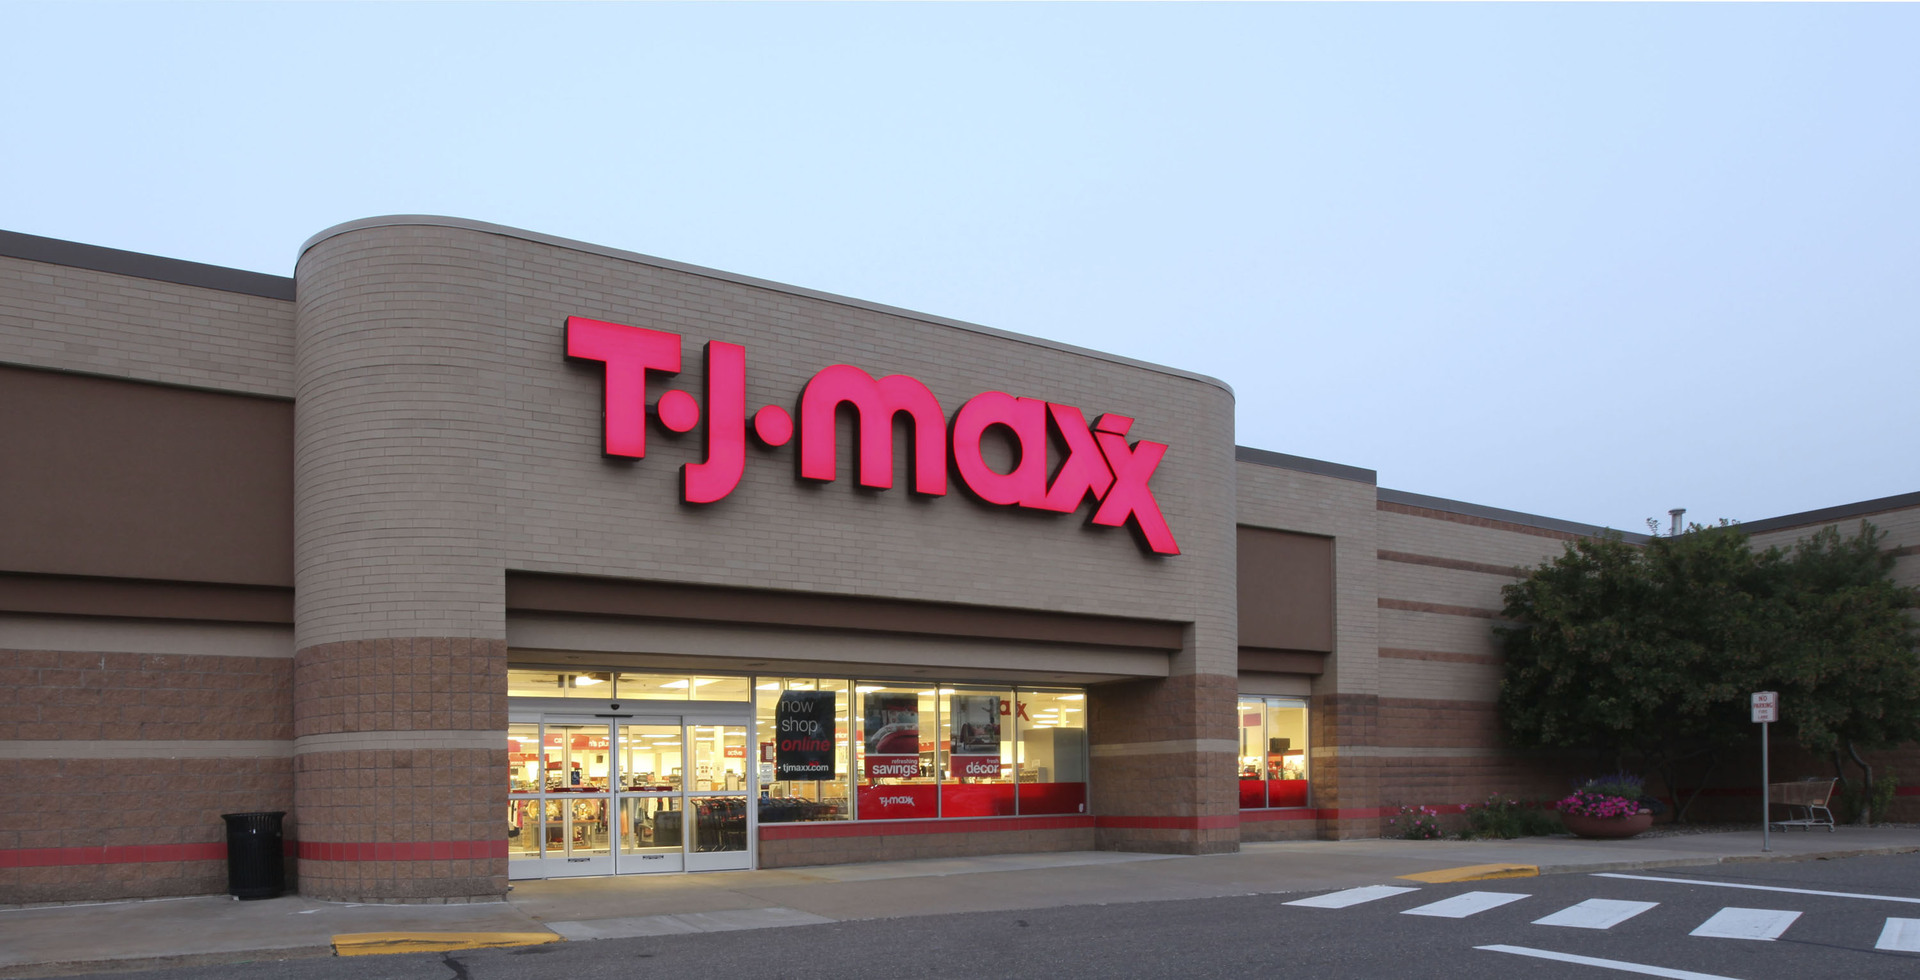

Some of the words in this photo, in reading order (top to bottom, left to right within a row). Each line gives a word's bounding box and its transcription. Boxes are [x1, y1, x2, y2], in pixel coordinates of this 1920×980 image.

[781, 700, 814, 713] now
[781, 716, 818, 735] shop
[781, 736, 831, 752] online
[782, 763, 829, 773] tjmaxx.com
[872, 764, 918, 777] savings
[966, 761, 999, 774] décor
